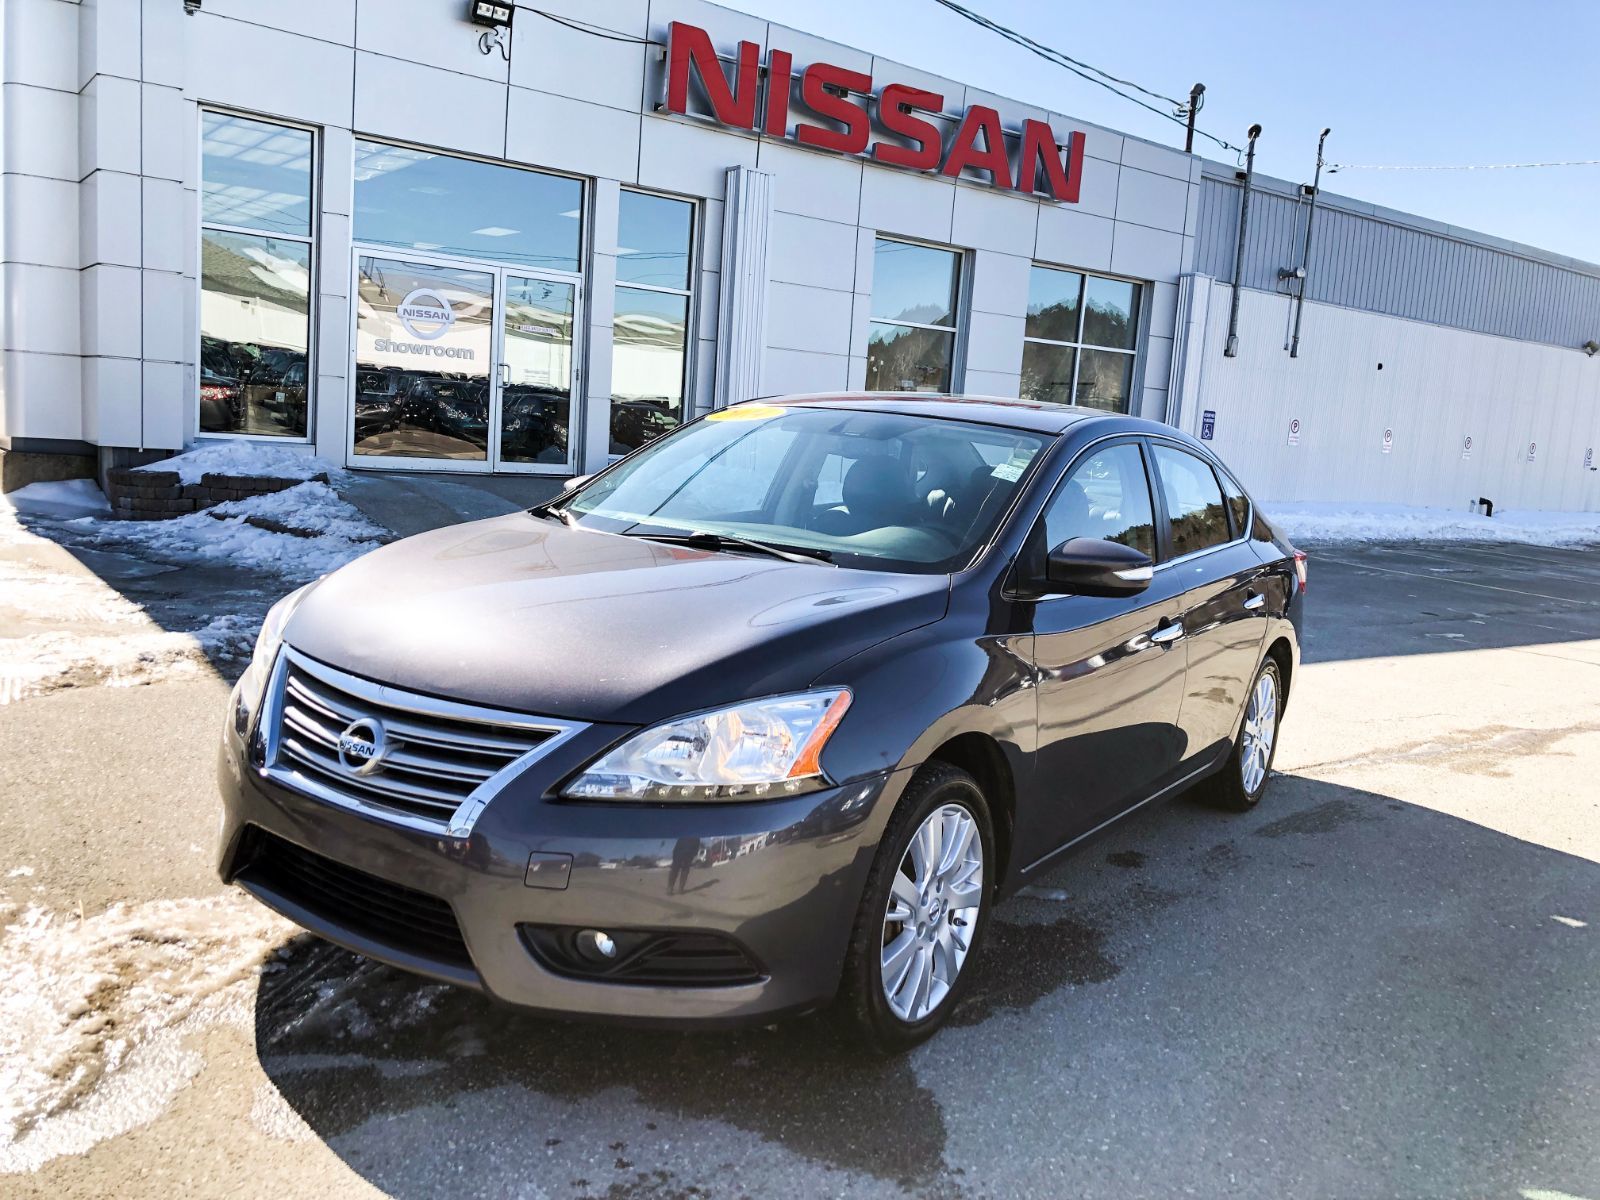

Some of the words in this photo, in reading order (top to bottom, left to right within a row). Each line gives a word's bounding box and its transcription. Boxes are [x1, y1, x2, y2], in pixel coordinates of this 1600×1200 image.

[667, 21, 1086, 204] NISSAN
[402, 308, 450, 321] NISSAN
[374, 339, 475, 360] Showroom
